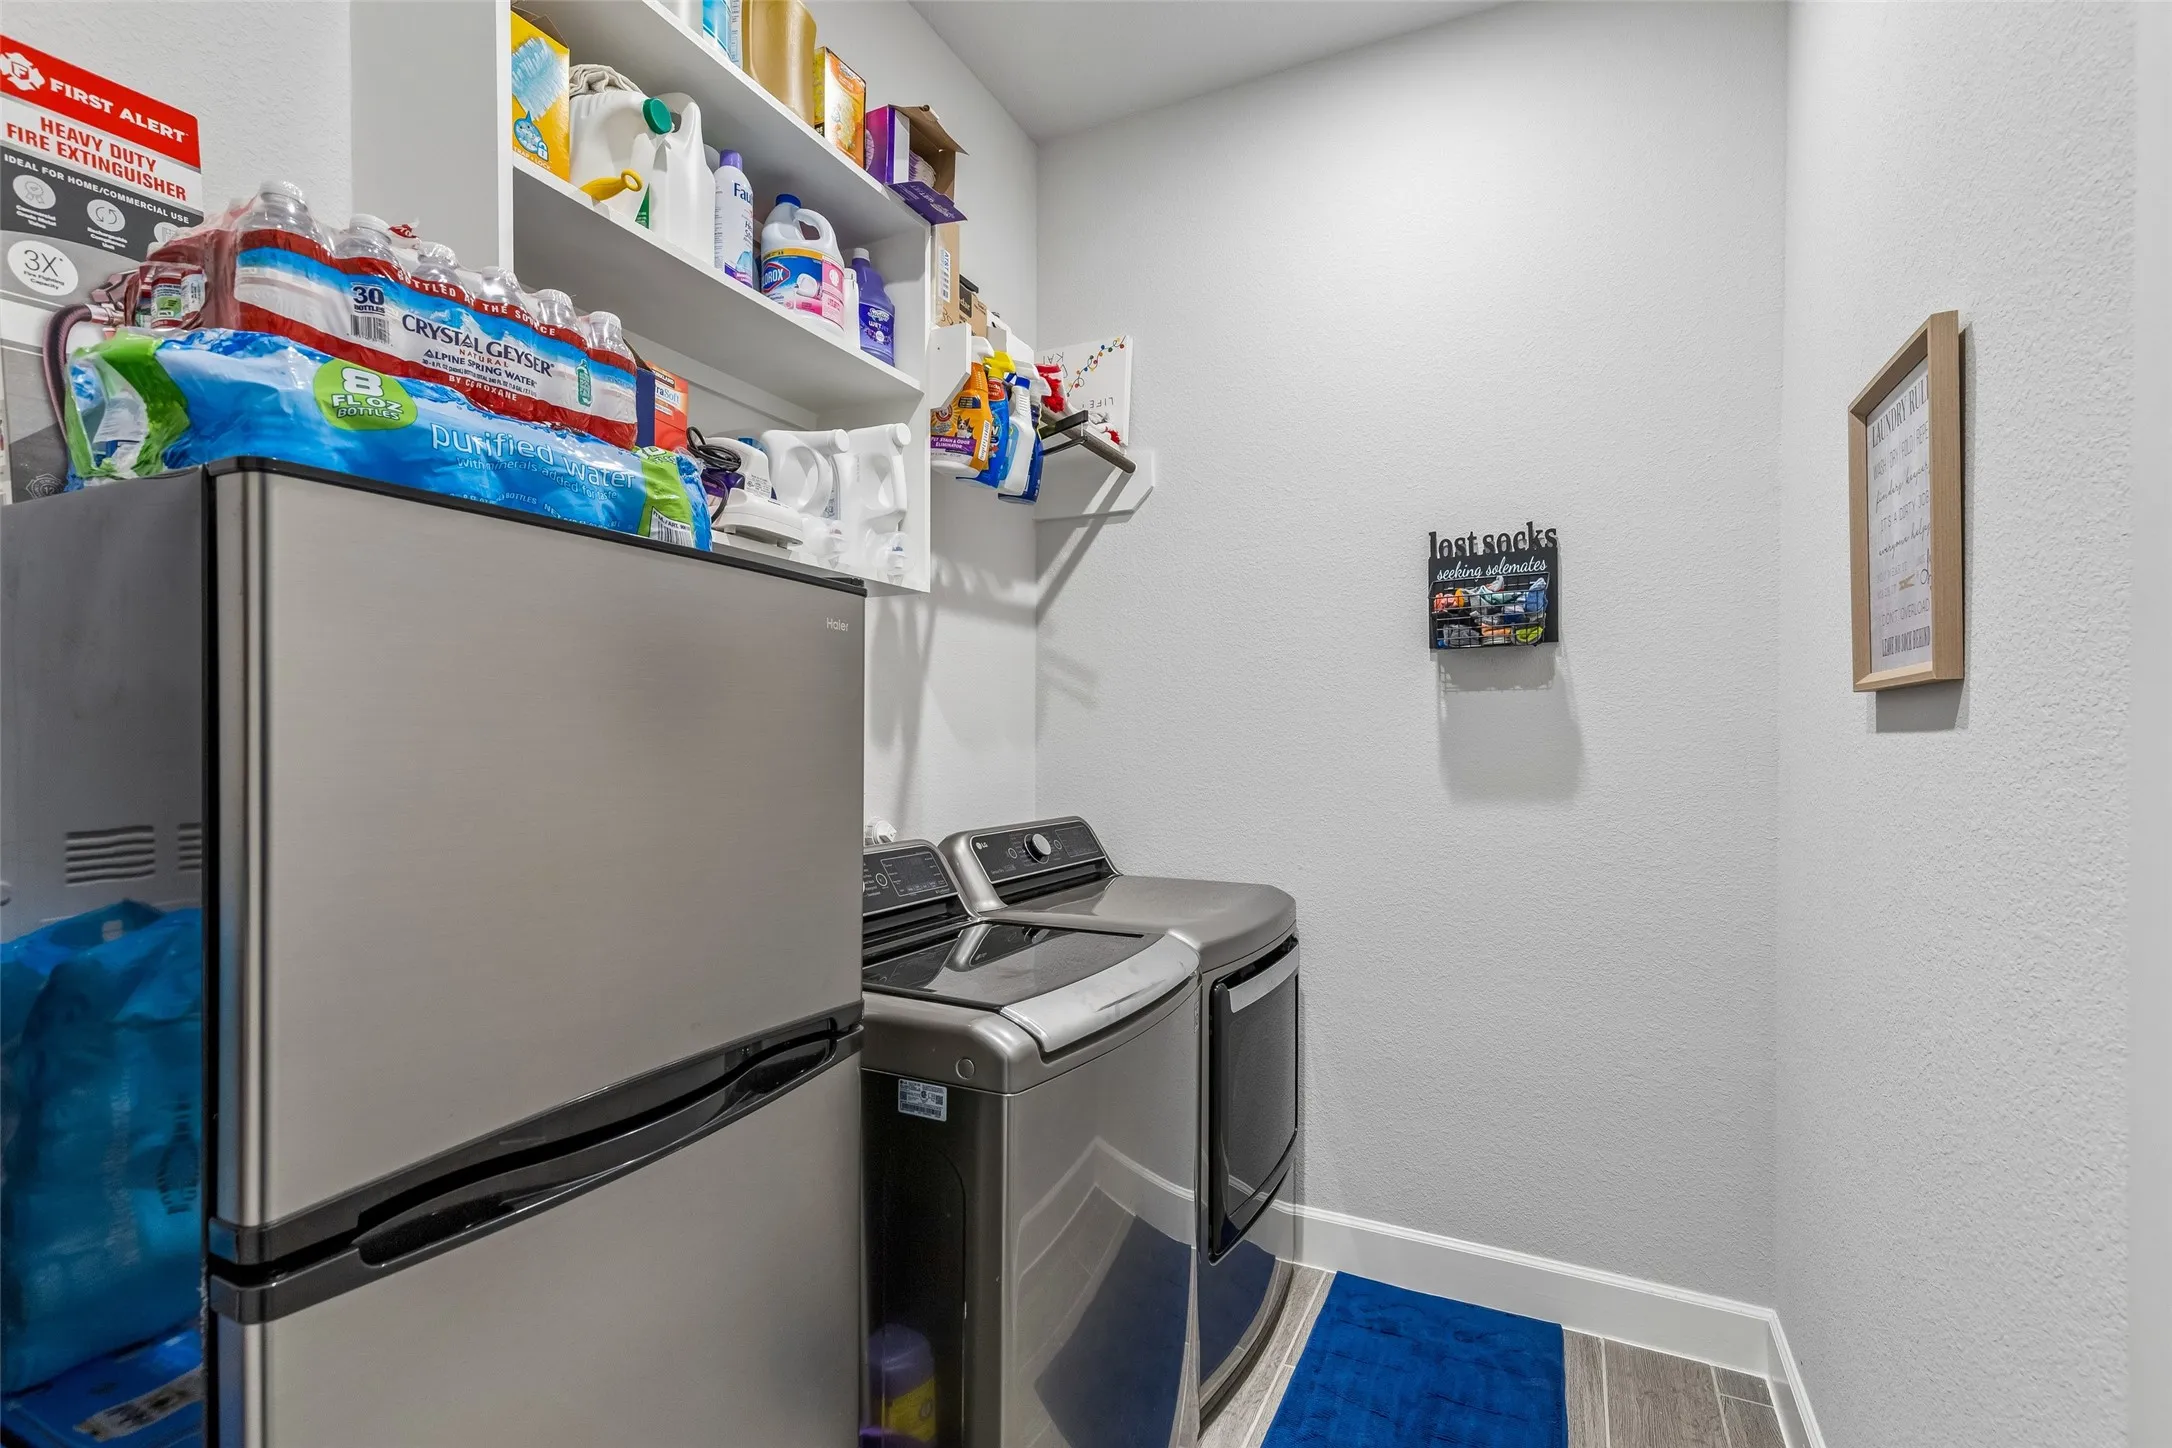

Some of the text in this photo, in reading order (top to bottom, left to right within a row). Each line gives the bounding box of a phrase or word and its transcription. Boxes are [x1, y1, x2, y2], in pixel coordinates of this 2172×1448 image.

[49, 77, 186, 143] FIRST ALERT
[40, 116, 157, 173] HEAVY DUTY
[7, 122, 187, 202] FIRE EXTINGUISHER
[4, 153, 190, 224] IDEAL FOR HOME/COMMERCIAL USE
[733, 182, 753, 206] Fau
[352, 286, 386, 306] 30
[354, 303, 386, 315] BOTTLES
[482, 302, 508, 315] THE
[401, 313, 553, 379] CRYSTAL GEYSER
[459, 347, 509, 369] NATURAL
[340, 366, 384, 398] 8
[422, 348, 537, 388] ALPINE SPRING WATER
[448, 374, 462, 385] BY
[331, 393, 405, 415] FL OZ
[336, 406, 402, 421] BOTTLES
[1871, 398, 1908, 449] LAUNDRY
[430, 422, 637, 490] purified water
[540, 466, 581, 494] added
[581, 484, 596, 500] for
[505, 492, 539, 506] BOTTLES
[1428, 520, 1558, 559] lost socks
[1436, 555, 1548, 582] seeking solemates
[826, 617, 849, 632] Haier
